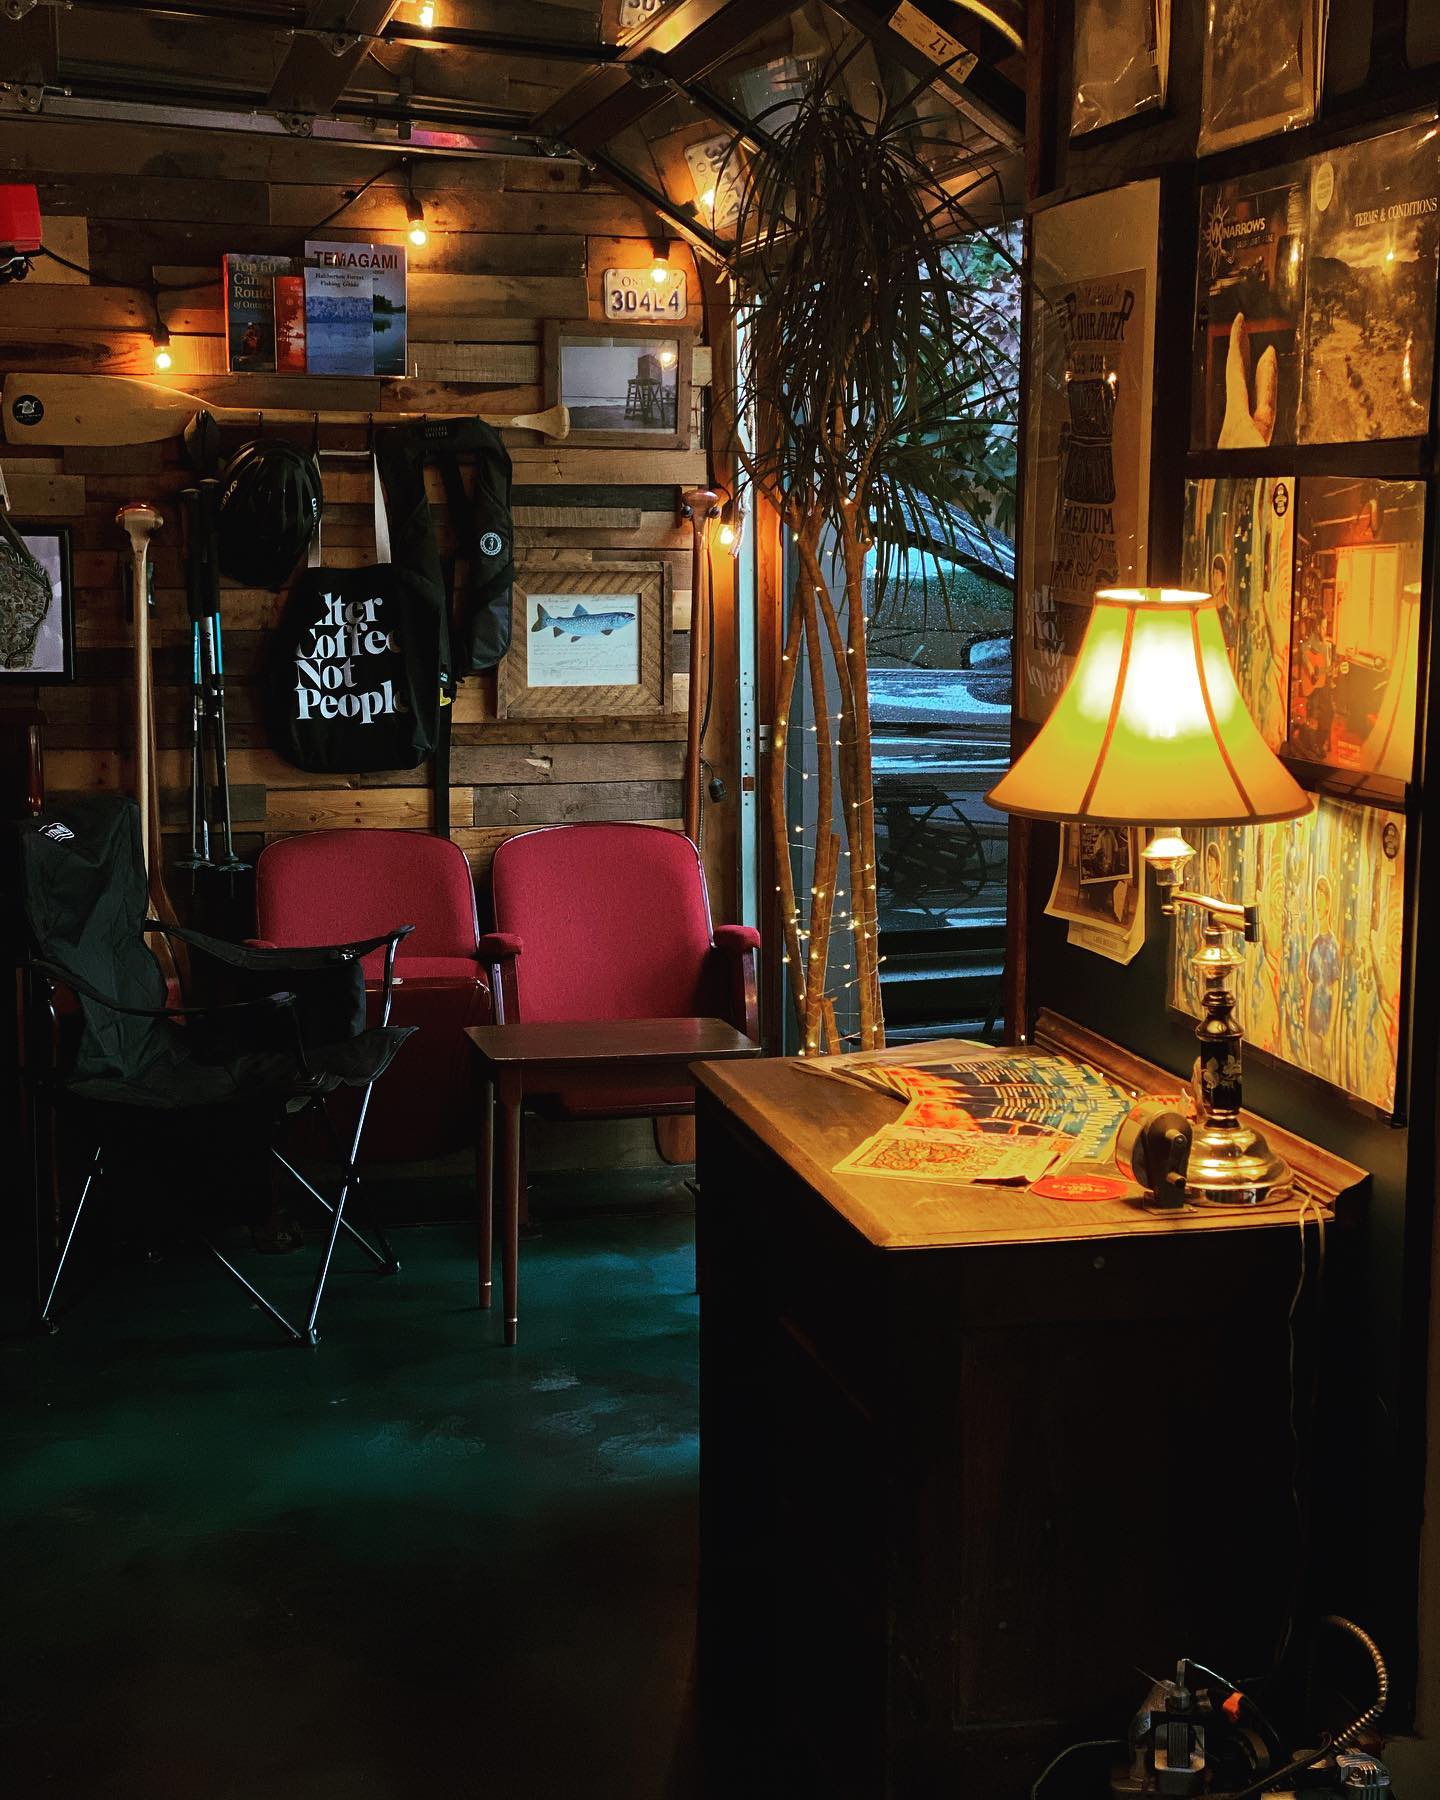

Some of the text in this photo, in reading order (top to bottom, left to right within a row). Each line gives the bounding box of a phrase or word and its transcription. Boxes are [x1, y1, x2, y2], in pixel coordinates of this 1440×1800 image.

[1355, 197, 1438, 228] TERMS & CONDITIONS
[314, 251, 398, 269] TEMAGAMI
[611, 289, 679, 313] 304L4
[1061, 506, 1115, 535] MEDIUM
[294, 657, 358, 690] Not
